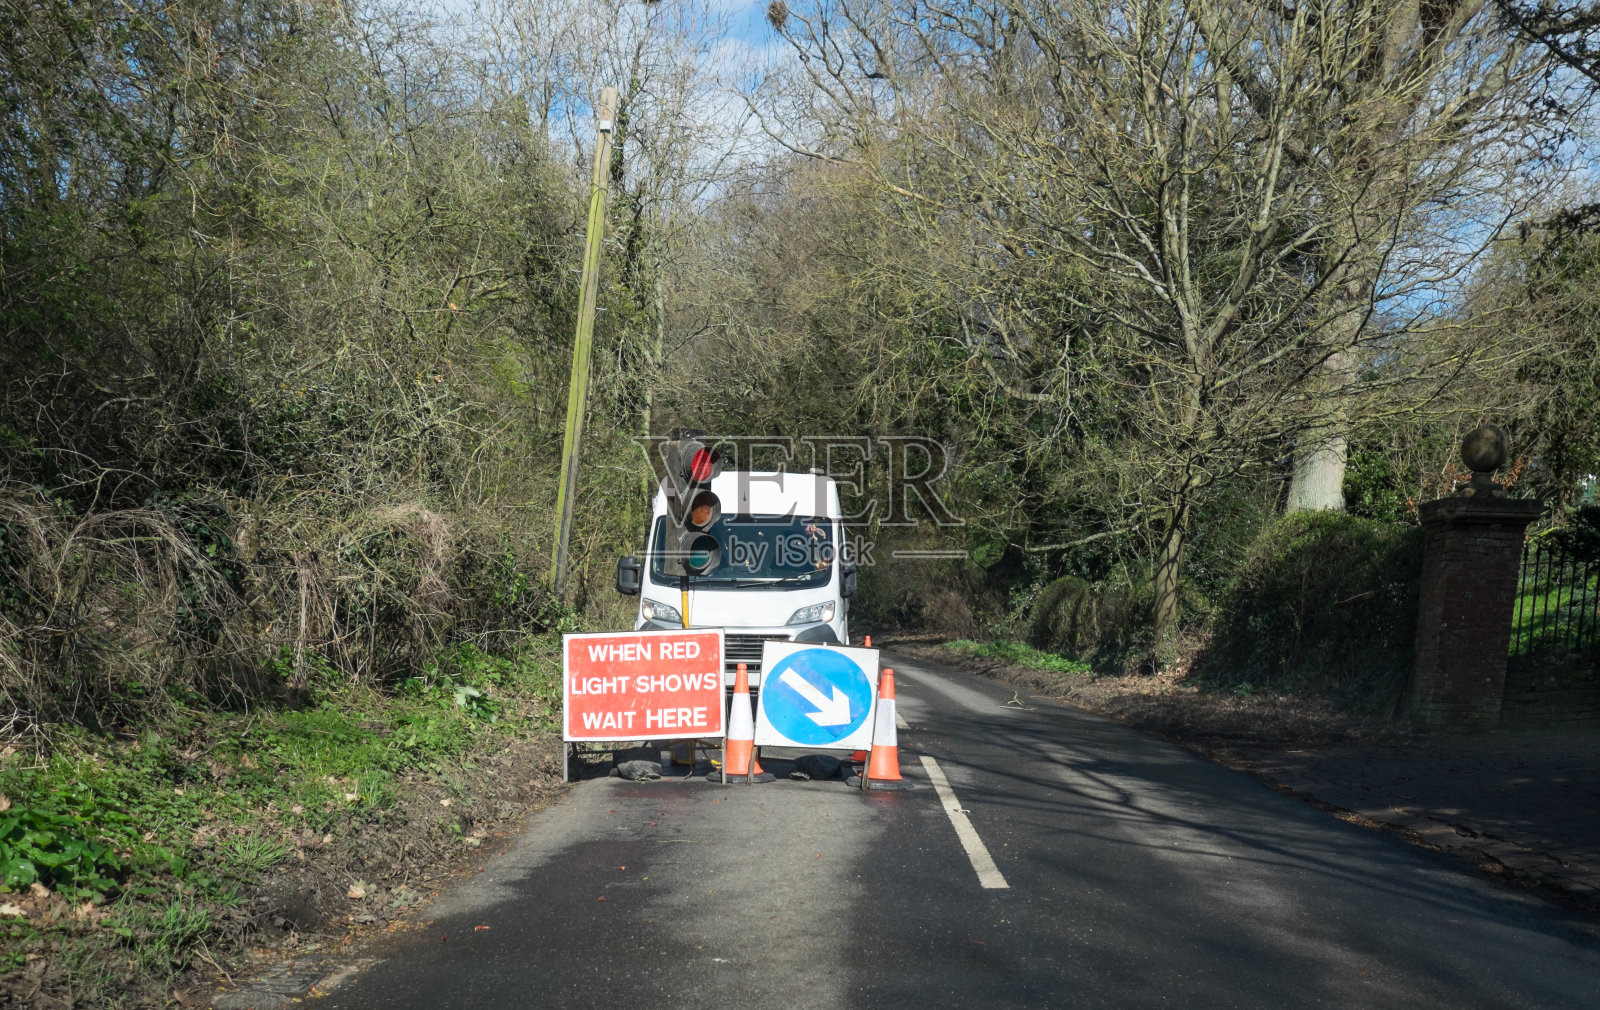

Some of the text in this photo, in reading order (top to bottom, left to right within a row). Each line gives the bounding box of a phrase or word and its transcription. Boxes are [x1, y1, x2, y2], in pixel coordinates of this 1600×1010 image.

[588, 641, 700, 662] WHEN RED
[571, 672, 717, 695] LIGHT SHOWS
[582, 706, 707, 730] WAIT HERE
